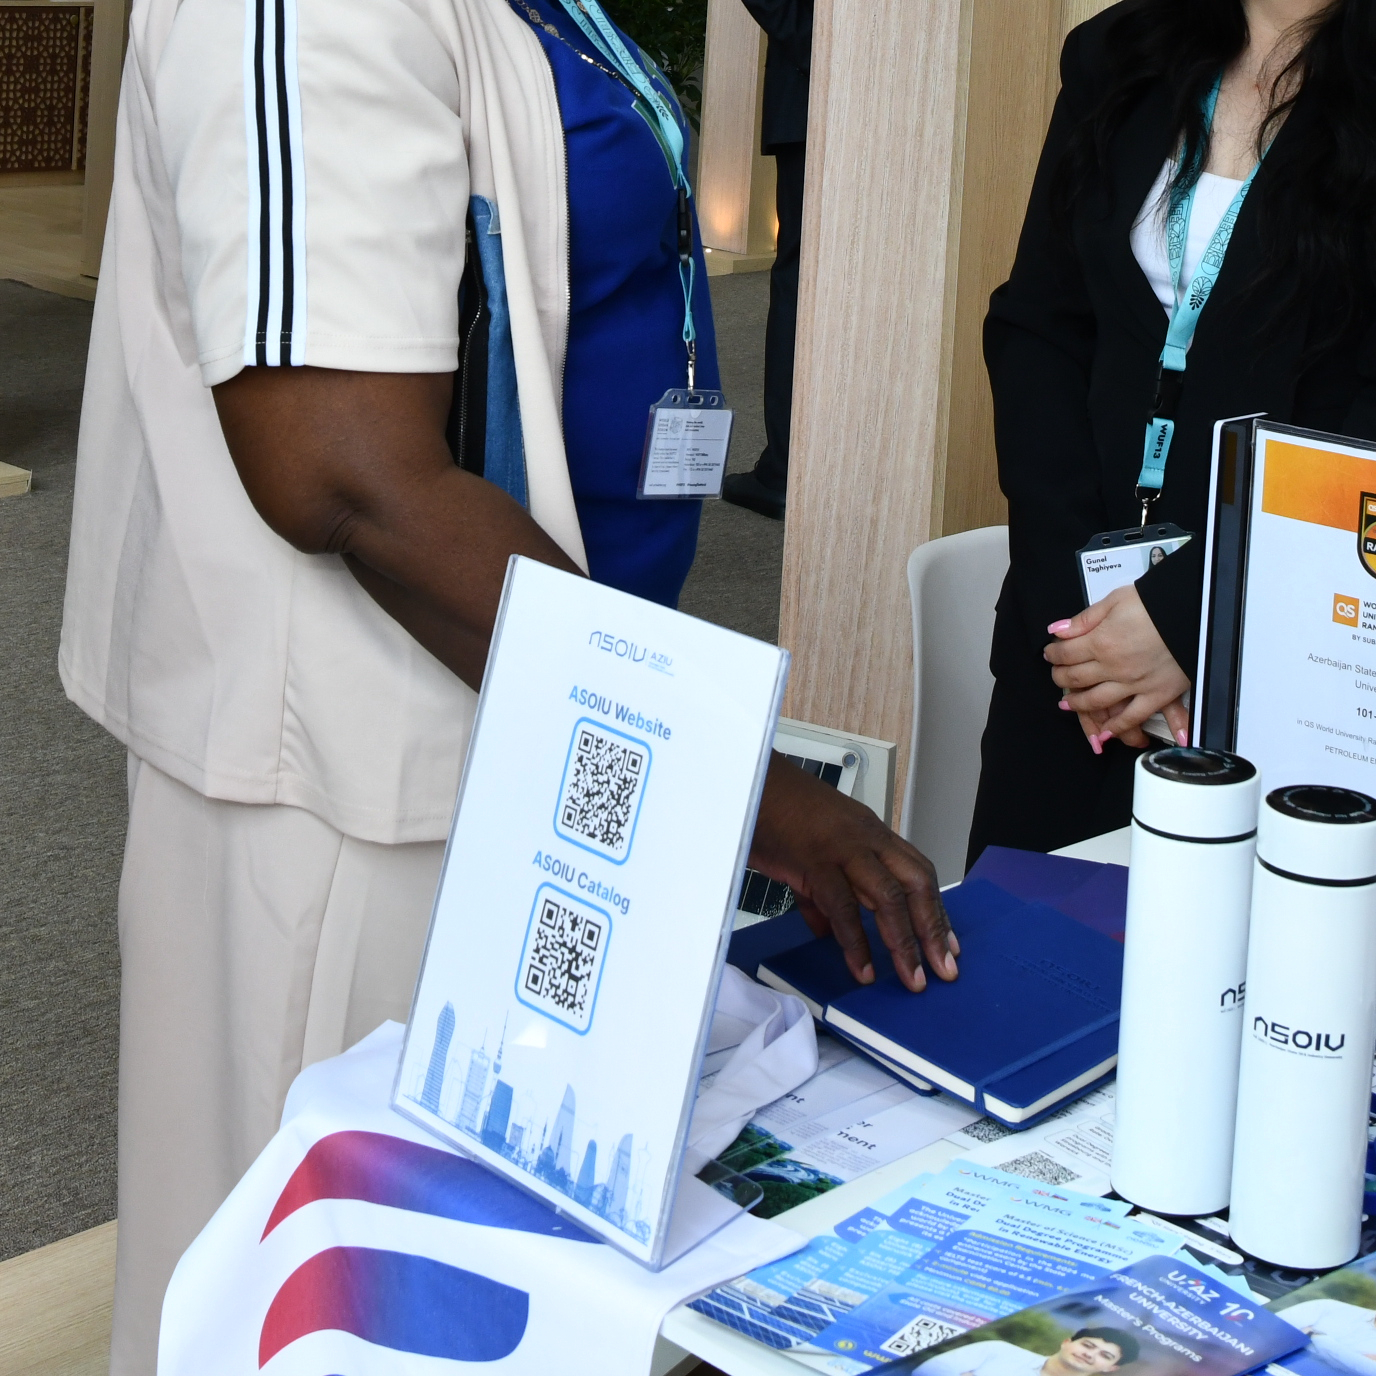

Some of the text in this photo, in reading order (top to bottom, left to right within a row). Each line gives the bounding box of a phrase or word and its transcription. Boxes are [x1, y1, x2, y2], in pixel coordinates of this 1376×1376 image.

[1153, 423, 1168, 459] WUF13
[1086, 556, 1107, 565] Gunel
[1087, 563, 1122, 573] Taghiyeva
[1336, 602, 1356, 619] QS
[651, 652, 673, 666] AZIU
[1307, 653, 1352, 671] Azerbaijan
[1355, 664, 1376, 677] State
[569, 685, 672, 740] ASOIU Website
[1304, 720, 1314, 729] QS
[1316, 723, 1334, 734] World
[1335, 728, 1366, 744] University
[1325, 744, 1369, 763] PETROLEUM
[532, 850, 630, 915] ASOIU Catalog
[1011, 1230, 1071, 1251] Renewable
[1074, 1249, 1113, 1264] Energy
[1023, 1226, 1061, 1241] Degree
[1064, 1238, 1128, 1261] Programme
[1058, 1229, 1097, 1244] Science
[1159, 1276, 1206, 1305] UNIVERSITY
[1093, 1294, 1203, 1363] Master's Programs
[1110, 1273, 1255, 1357] FRENCH-AZERBAIJANI
[1129, 1291, 1209, 1340] UNIVERSITY
